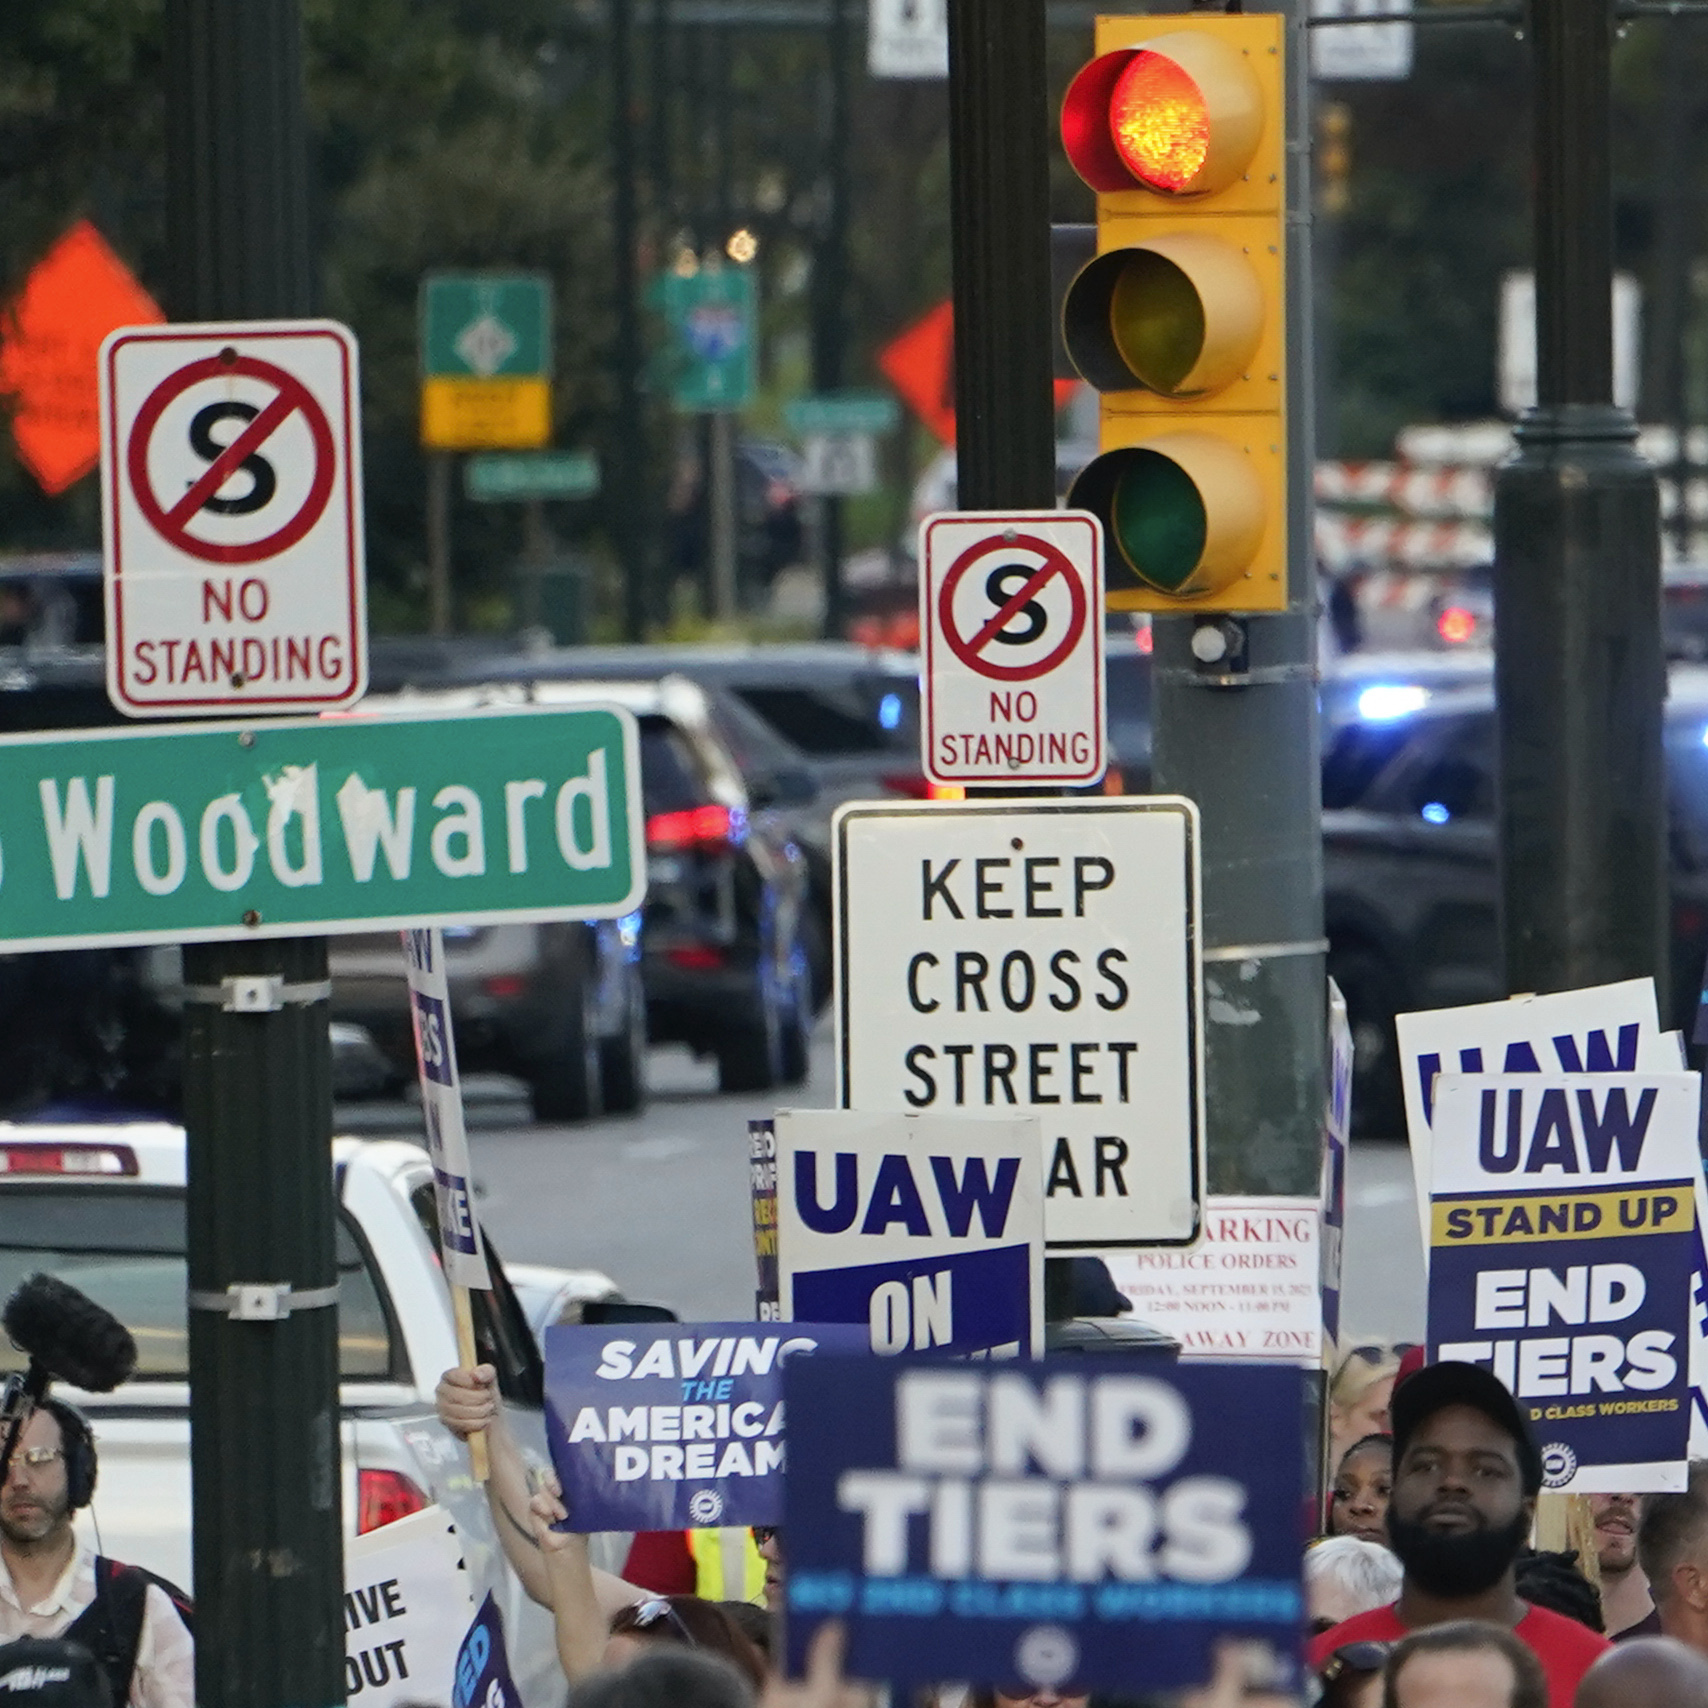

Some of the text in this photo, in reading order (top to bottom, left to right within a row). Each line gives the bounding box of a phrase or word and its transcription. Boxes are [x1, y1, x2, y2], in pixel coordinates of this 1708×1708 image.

[202, 578, 270, 623] NO
[133, 634, 344, 688] STANDING
[989, 691, 1037, 722] NO
[941, 732, 1090, 767] STANDING
[39, 748, 612, 901] Woodward
[921, 855, 1117, 921] KEEP
[907, 948, 1130, 1014] CROSS
[902, 1042, 1139, 1107] STREET
[1478, 1086, 1660, 1175] UAW
[793, 1148, 1021, 1241] UAW
[1445, 1196, 1679, 1240] STAND UP
[1137, 1252, 1298, 1271] POLICE ORDERS
[1182, 1283, 1268, 1298] SEPTEMBER
[869, 1269, 954, 1359] ON
[1184, 1301, 1226, 1314] NOON
[1474, 1262, 1648, 1331] END
[1184, 1330, 1316, 1349] AWAY ZONE
[1438, 1330, 1678, 1400] TIERS
[681, 1378, 735, 1402] THE
[1545, 1402, 1597, 1421] CLASS
[1599, 1398, 1679, 1417] WORKERS
[896, 1368, 1194, 1485] END
[835, 1475, 1256, 1585] TIERS
